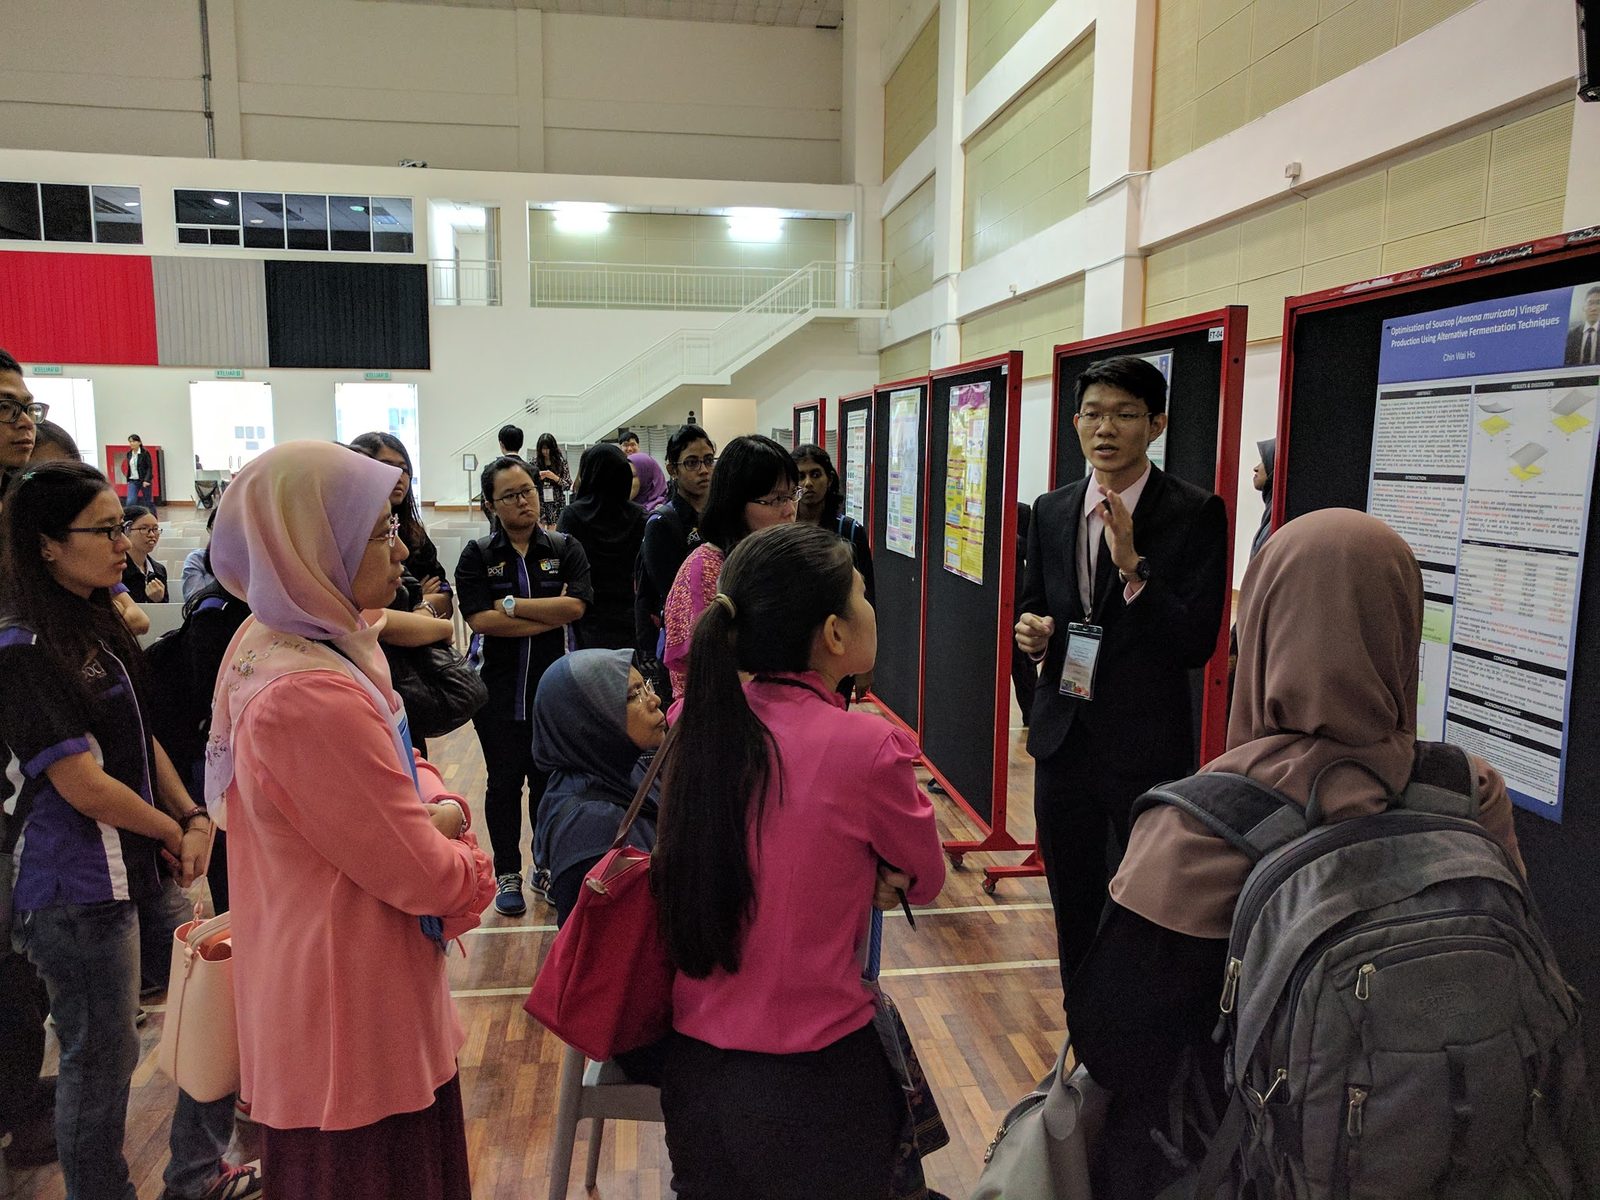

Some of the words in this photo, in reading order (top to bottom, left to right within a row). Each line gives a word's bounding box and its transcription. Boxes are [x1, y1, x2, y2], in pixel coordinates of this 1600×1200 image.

[1391, 323, 1425, 336] Optimisation
[1425, 321, 1432, 330] of
[1432, 318, 1455, 329] Soursop
[1455, 313, 1482, 326] (Annona
[1483, 306, 1518, 320] muricata)
[1519, 303, 1549, 314] Vinegar
[1209, 331, 1222, 339] FT-04
[1391, 336, 1421, 348] Production
[1420, 334, 1437, 344] Using
[1436, 329, 1468, 341] Alternative
[1469, 322, 1516, 336] Fermentation
[1518, 316, 1560, 329] Techniques
[1443, 353, 1455, 362] Chin
[1456, 351, 1467, 360] Wai
[1467, 351, 1476, 359] Ho
